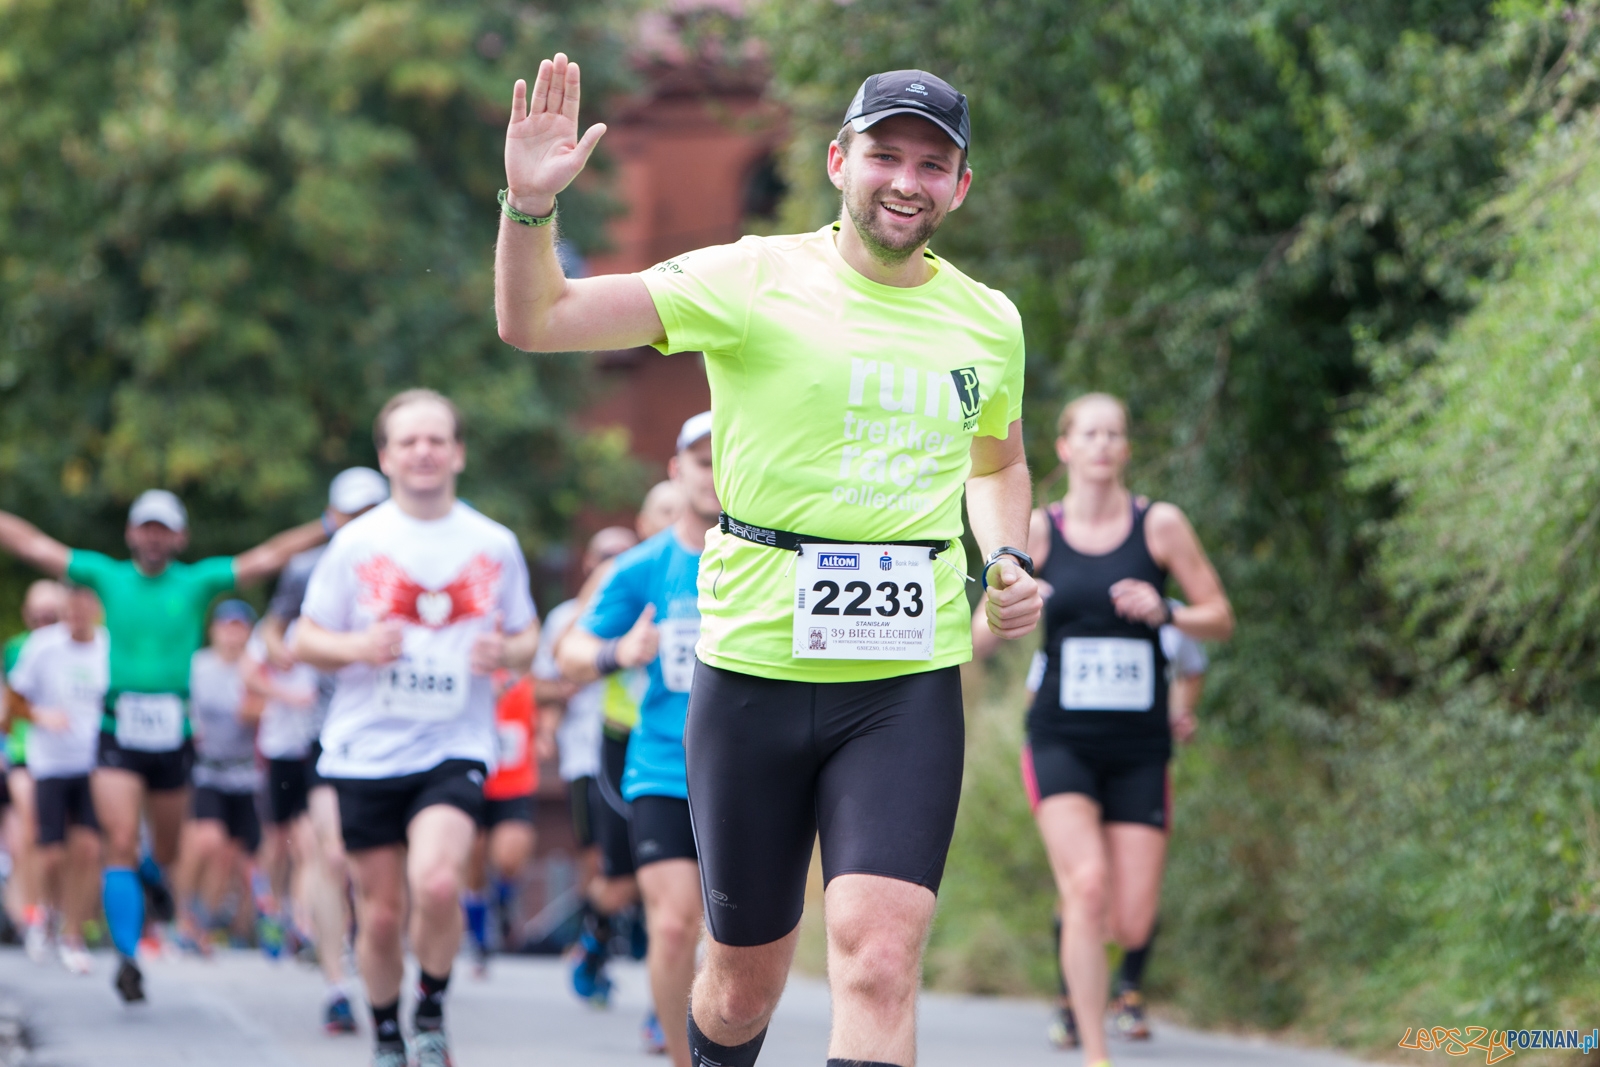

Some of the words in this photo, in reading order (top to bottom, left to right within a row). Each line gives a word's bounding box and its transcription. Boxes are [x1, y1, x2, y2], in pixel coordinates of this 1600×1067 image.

[848, 358, 961, 423] run
[843, 411, 955, 456] trekker
[839, 445, 939, 489] race
[832, 485, 934, 513] collection
[811, 580, 924, 617] 2233
[831, 628, 845, 639] 39
[849, 629, 876, 639] BIEG
[880, 627, 925, 639] LECHITÓW
